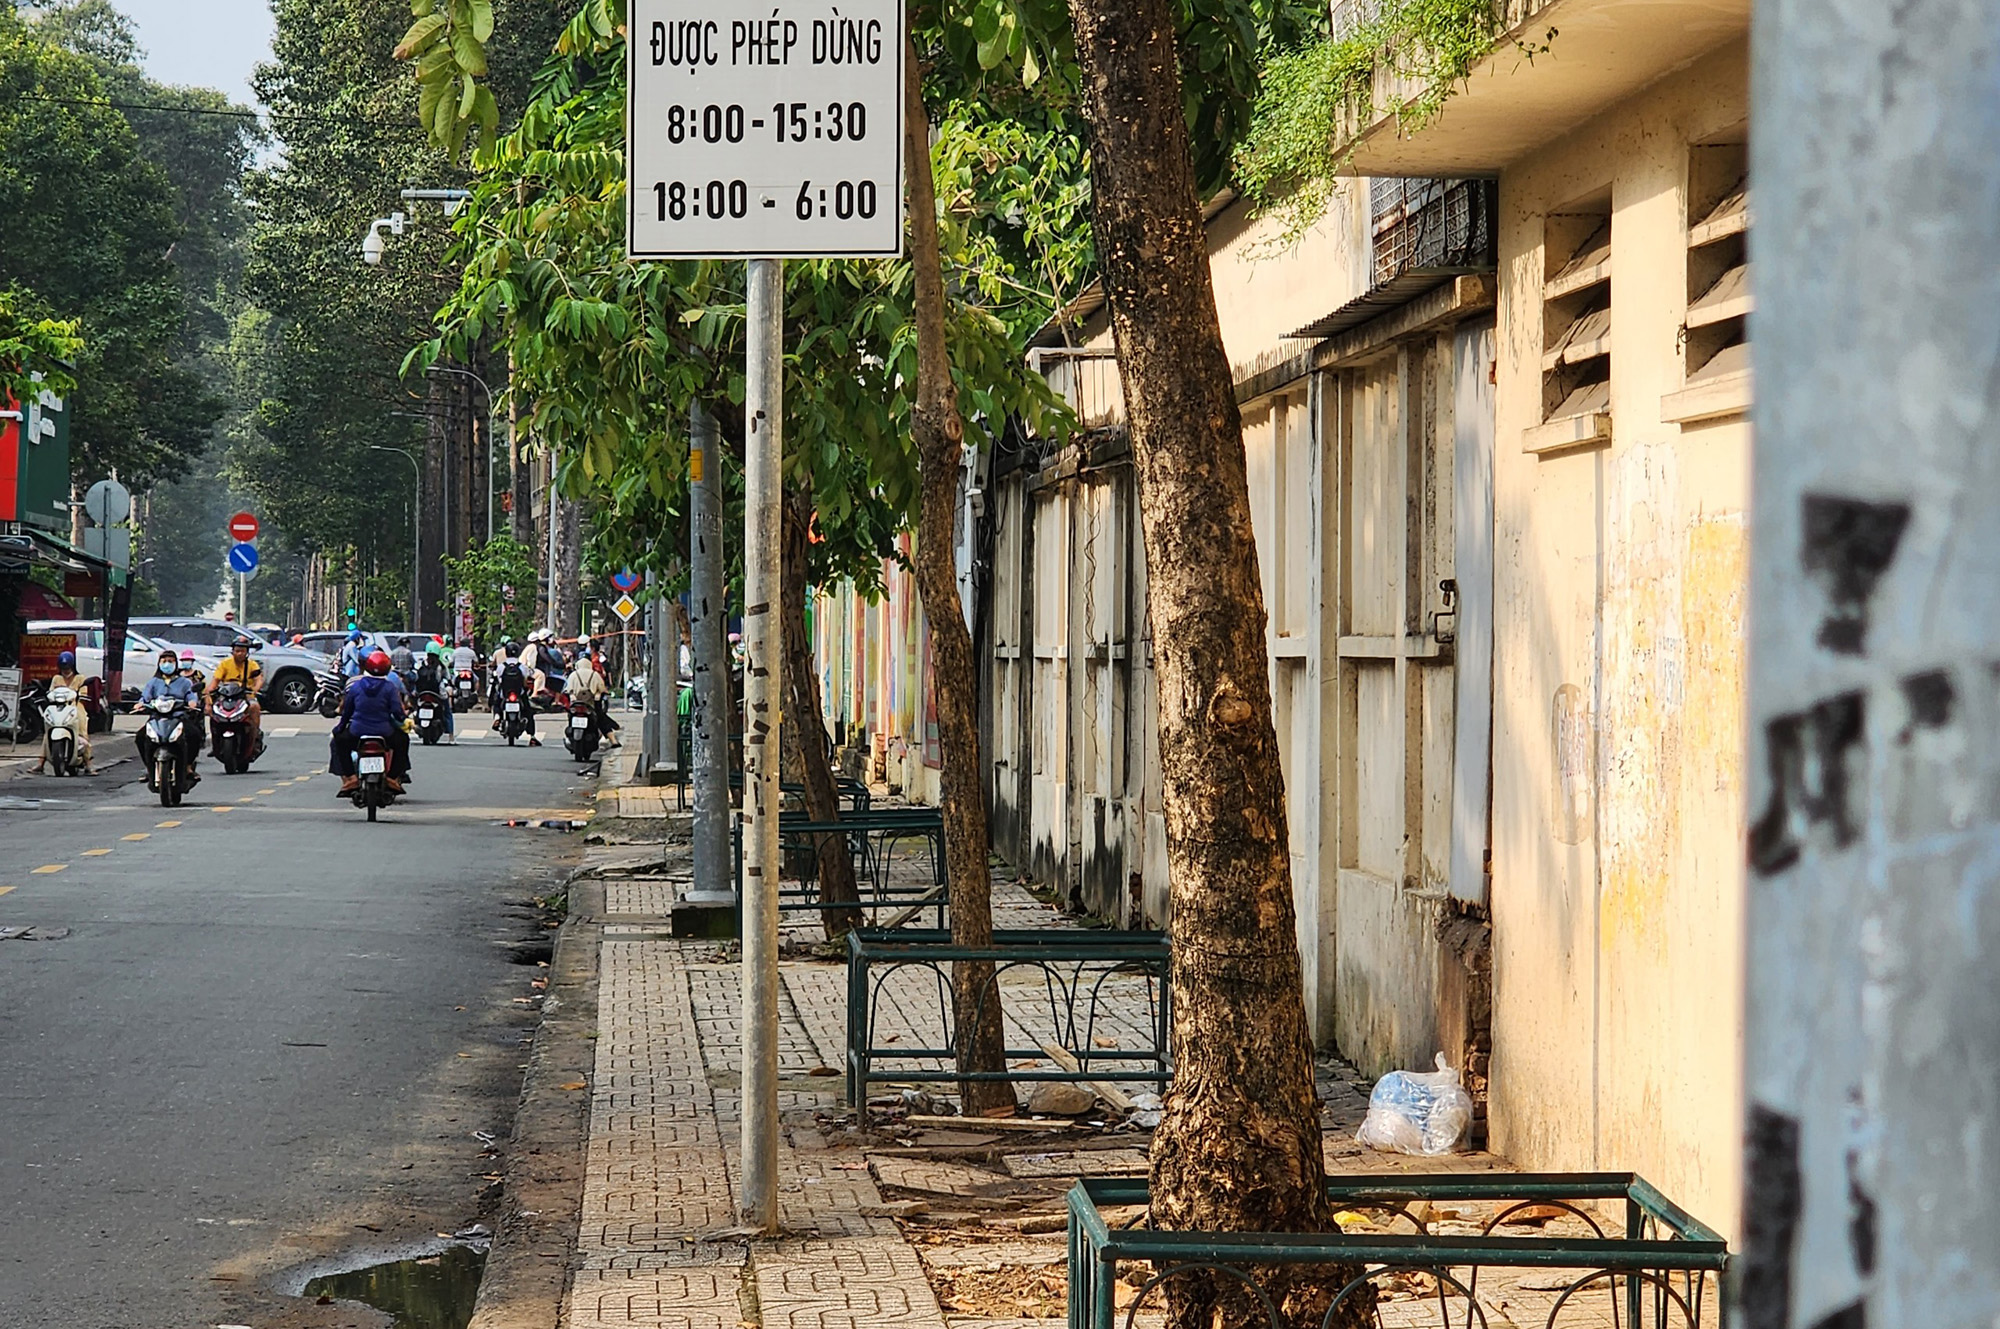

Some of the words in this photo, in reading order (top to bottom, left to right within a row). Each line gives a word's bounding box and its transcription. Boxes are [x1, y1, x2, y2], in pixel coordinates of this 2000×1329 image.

[650, 19, 718, 75] ĐƯỢC
[732, 8, 798, 65] PHÉP
[812, 7, 881, 65] DỪNG
[653, 180, 747, 221] 18:00
[796, 180, 876, 220] 6:00
[23, 635, 74, 647] PHOTOCOPY
